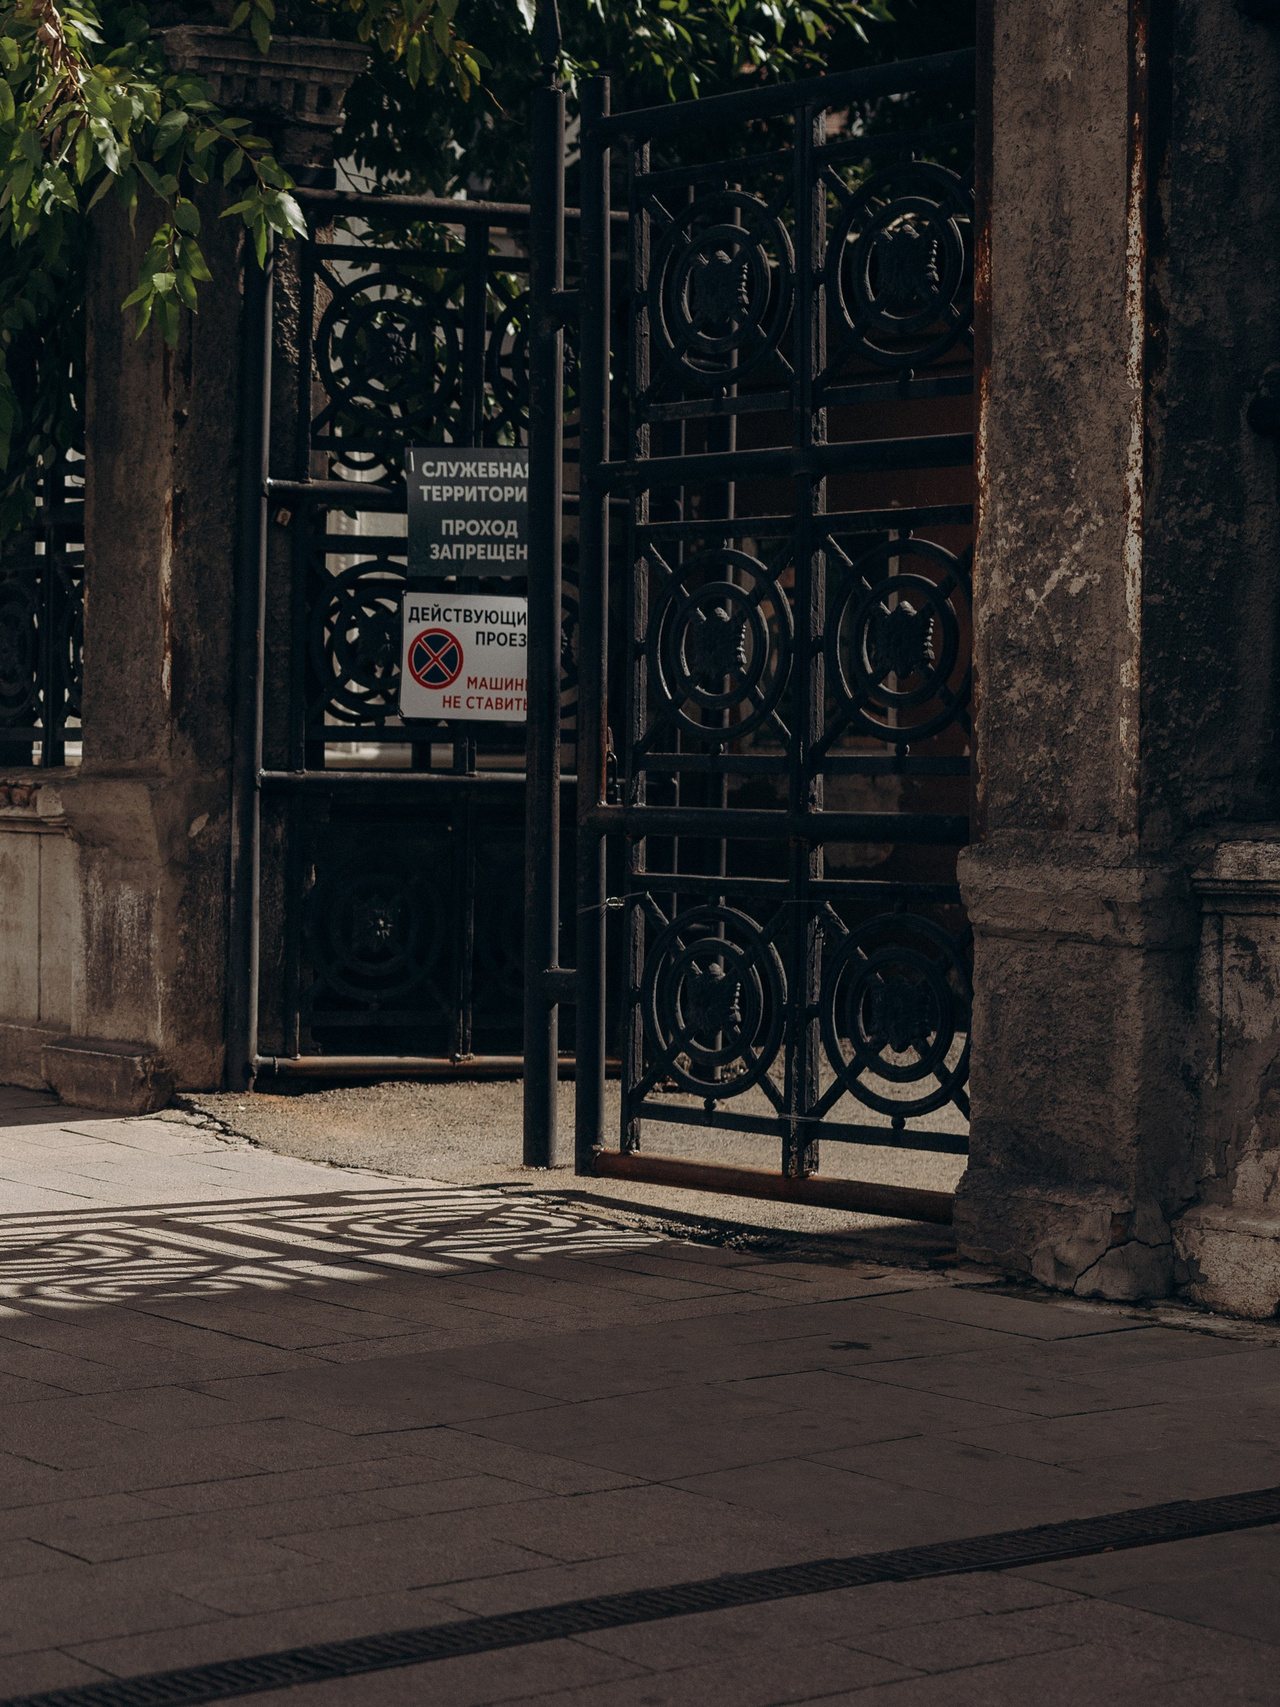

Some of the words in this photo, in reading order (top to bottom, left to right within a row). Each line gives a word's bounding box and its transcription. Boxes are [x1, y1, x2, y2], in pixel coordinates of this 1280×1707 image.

[419, 485, 527, 502] ТЕРРИТОРИ
[441, 519, 518, 538] ПРОХОД
[430, 544, 528, 562] ЗАПРЕЩЕН
[408, 603, 527, 627] ДЕЙСТВУЮЩИ
[475, 631, 527, 647] ПРОЕЗ
[467, 676, 527, 691] МАШИН
[442, 695, 461, 709] НЕ
